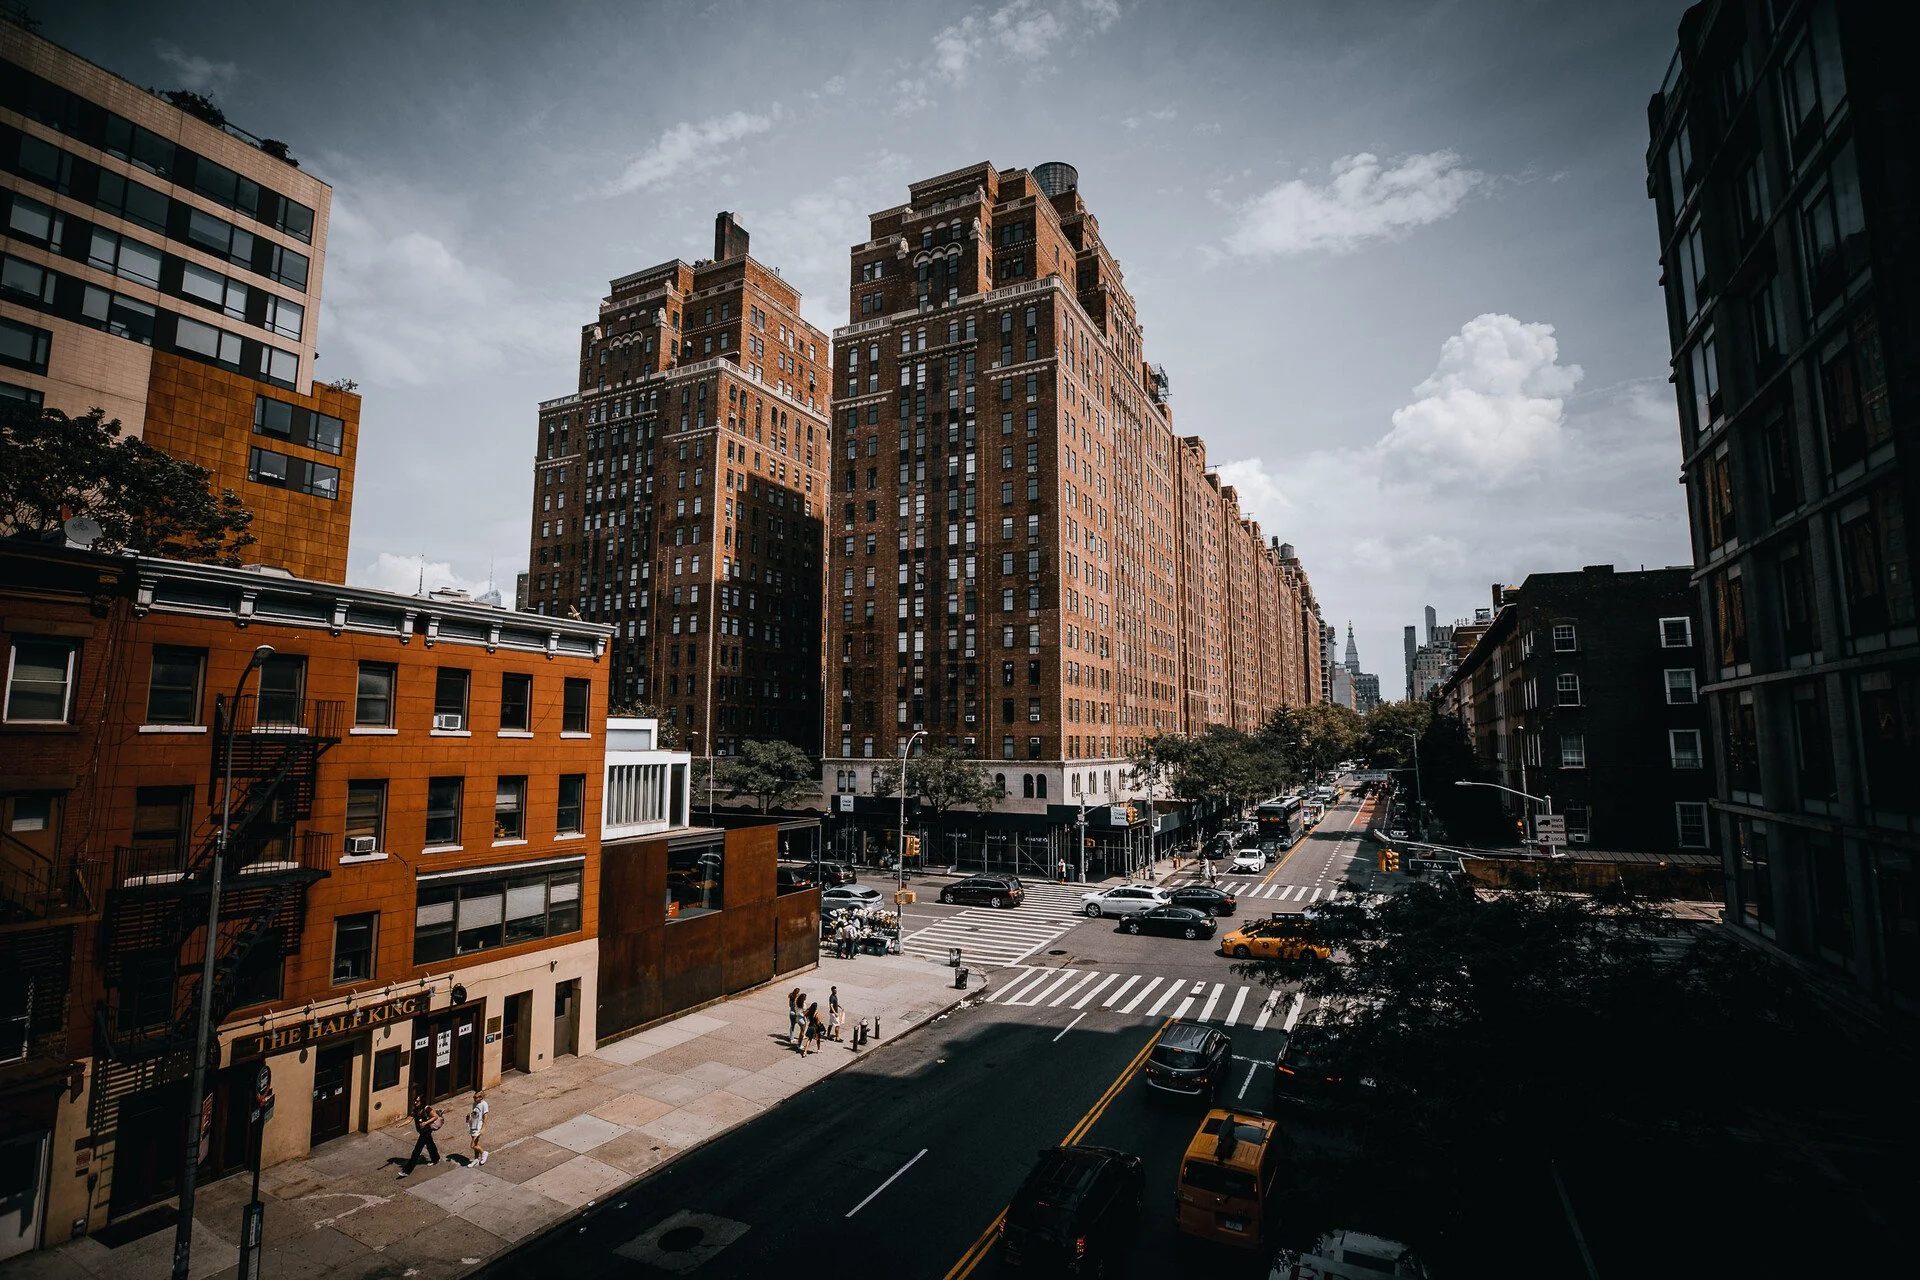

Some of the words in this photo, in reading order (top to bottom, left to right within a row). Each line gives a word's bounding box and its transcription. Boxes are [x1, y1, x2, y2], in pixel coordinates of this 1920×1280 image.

[256, 1027, 302, 1053] THE
[308, 1013, 364, 1039] HALF
[368, 998, 417, 1024] KING
